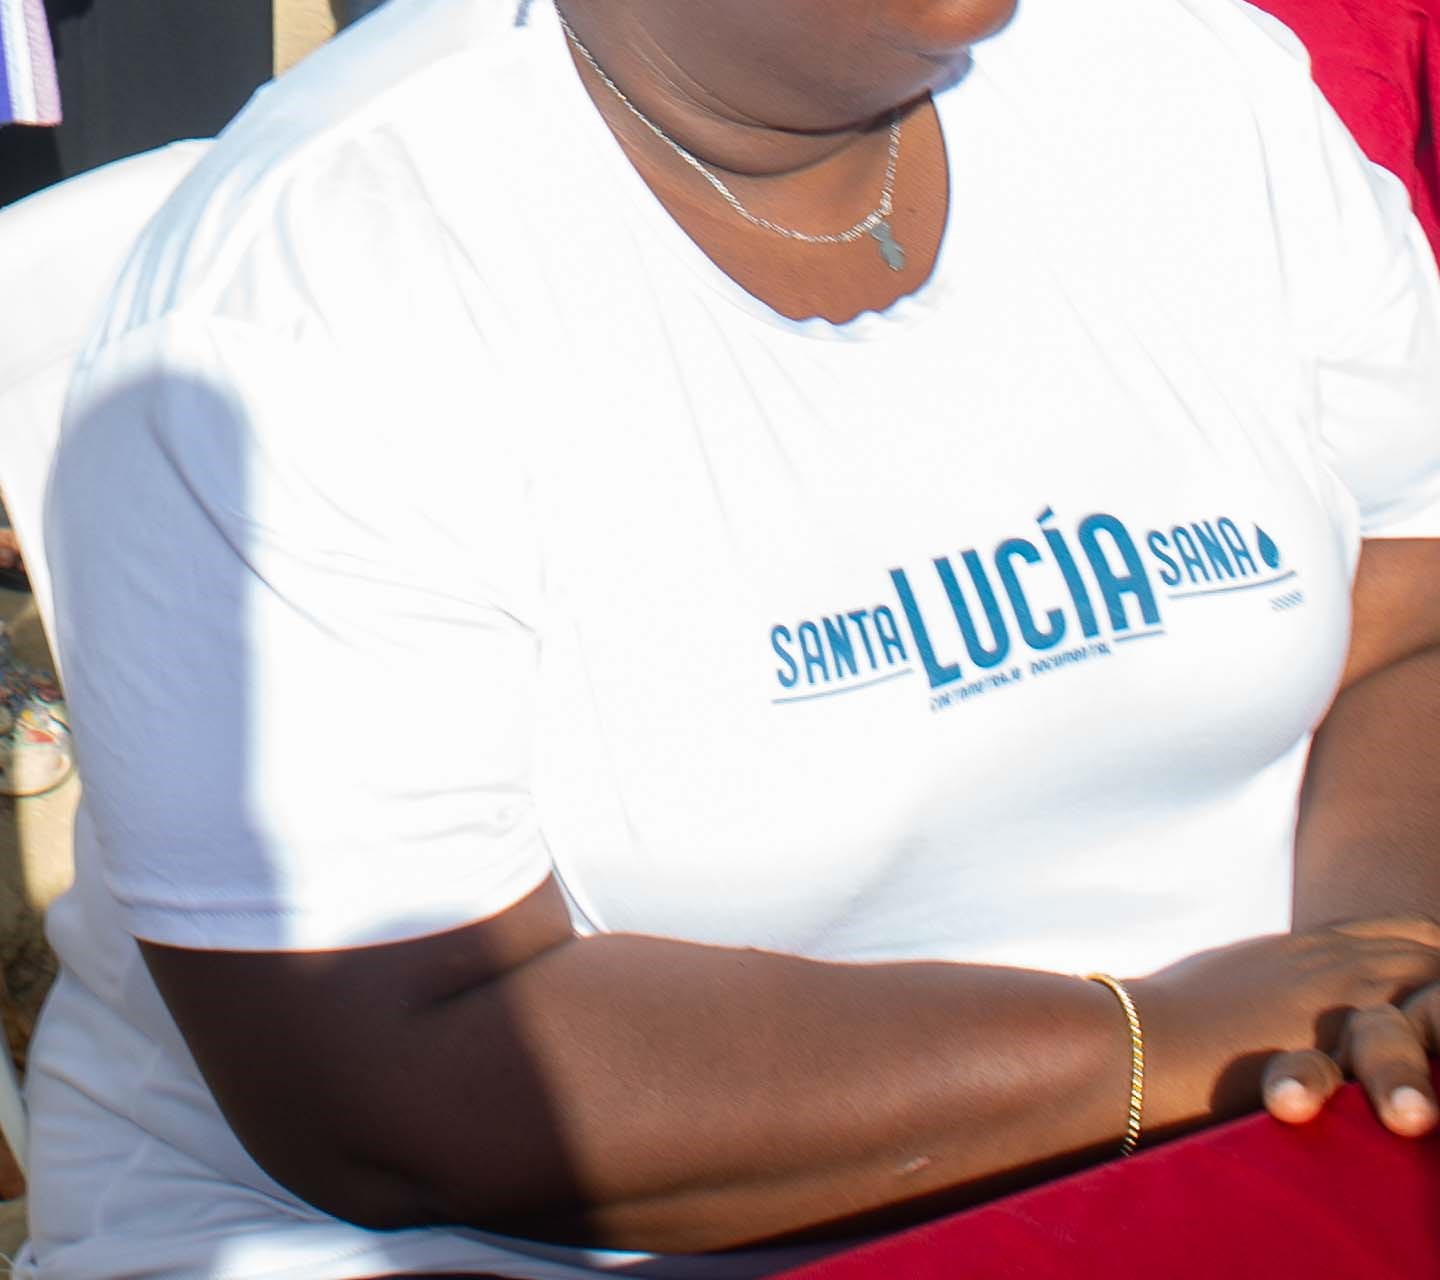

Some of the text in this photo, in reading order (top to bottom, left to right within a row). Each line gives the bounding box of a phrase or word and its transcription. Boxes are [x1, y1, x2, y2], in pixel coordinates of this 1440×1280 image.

[770, 504, 1258, 690] SANTA LUCÍA SANA
